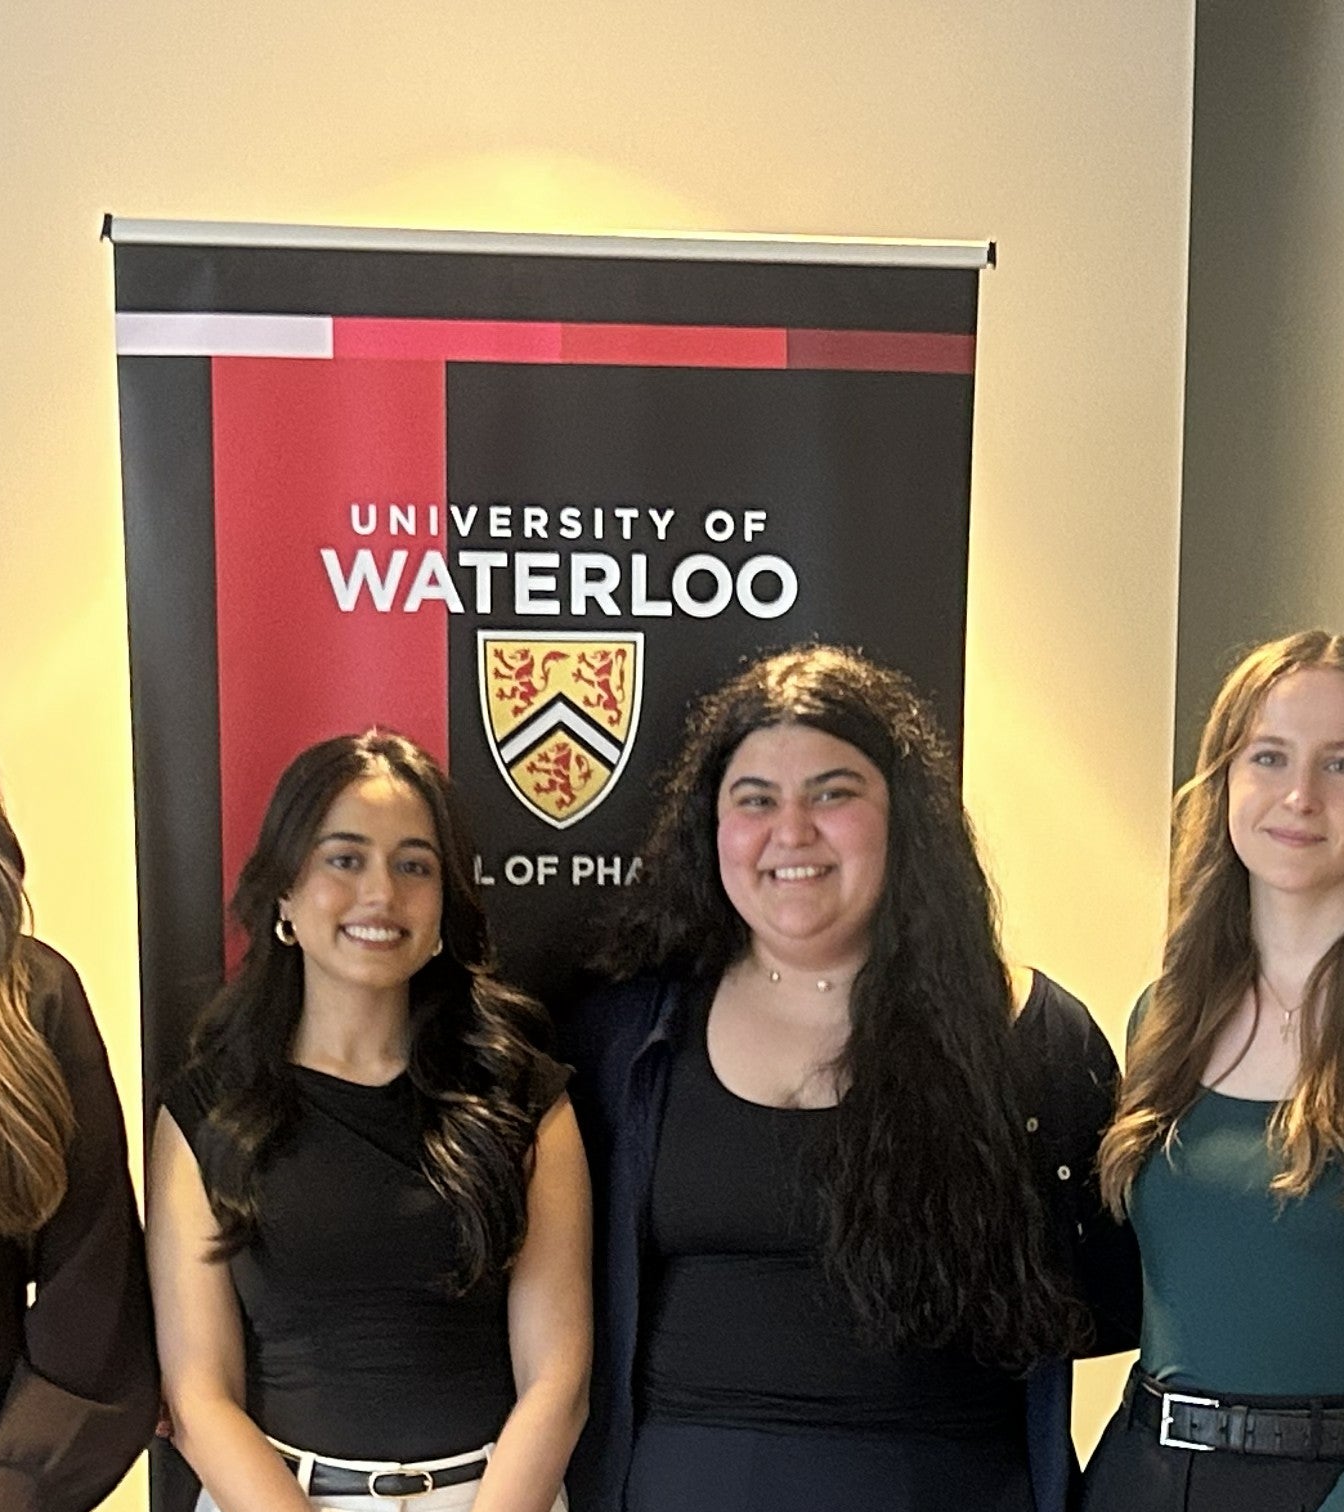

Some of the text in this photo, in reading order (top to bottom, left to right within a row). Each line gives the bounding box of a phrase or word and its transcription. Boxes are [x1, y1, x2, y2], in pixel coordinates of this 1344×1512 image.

[350, 503, 768, 542] UNIVERSITY OF
[320, 548, 798, 619] WATERLOO
[504, 855, 560, 885] OF
